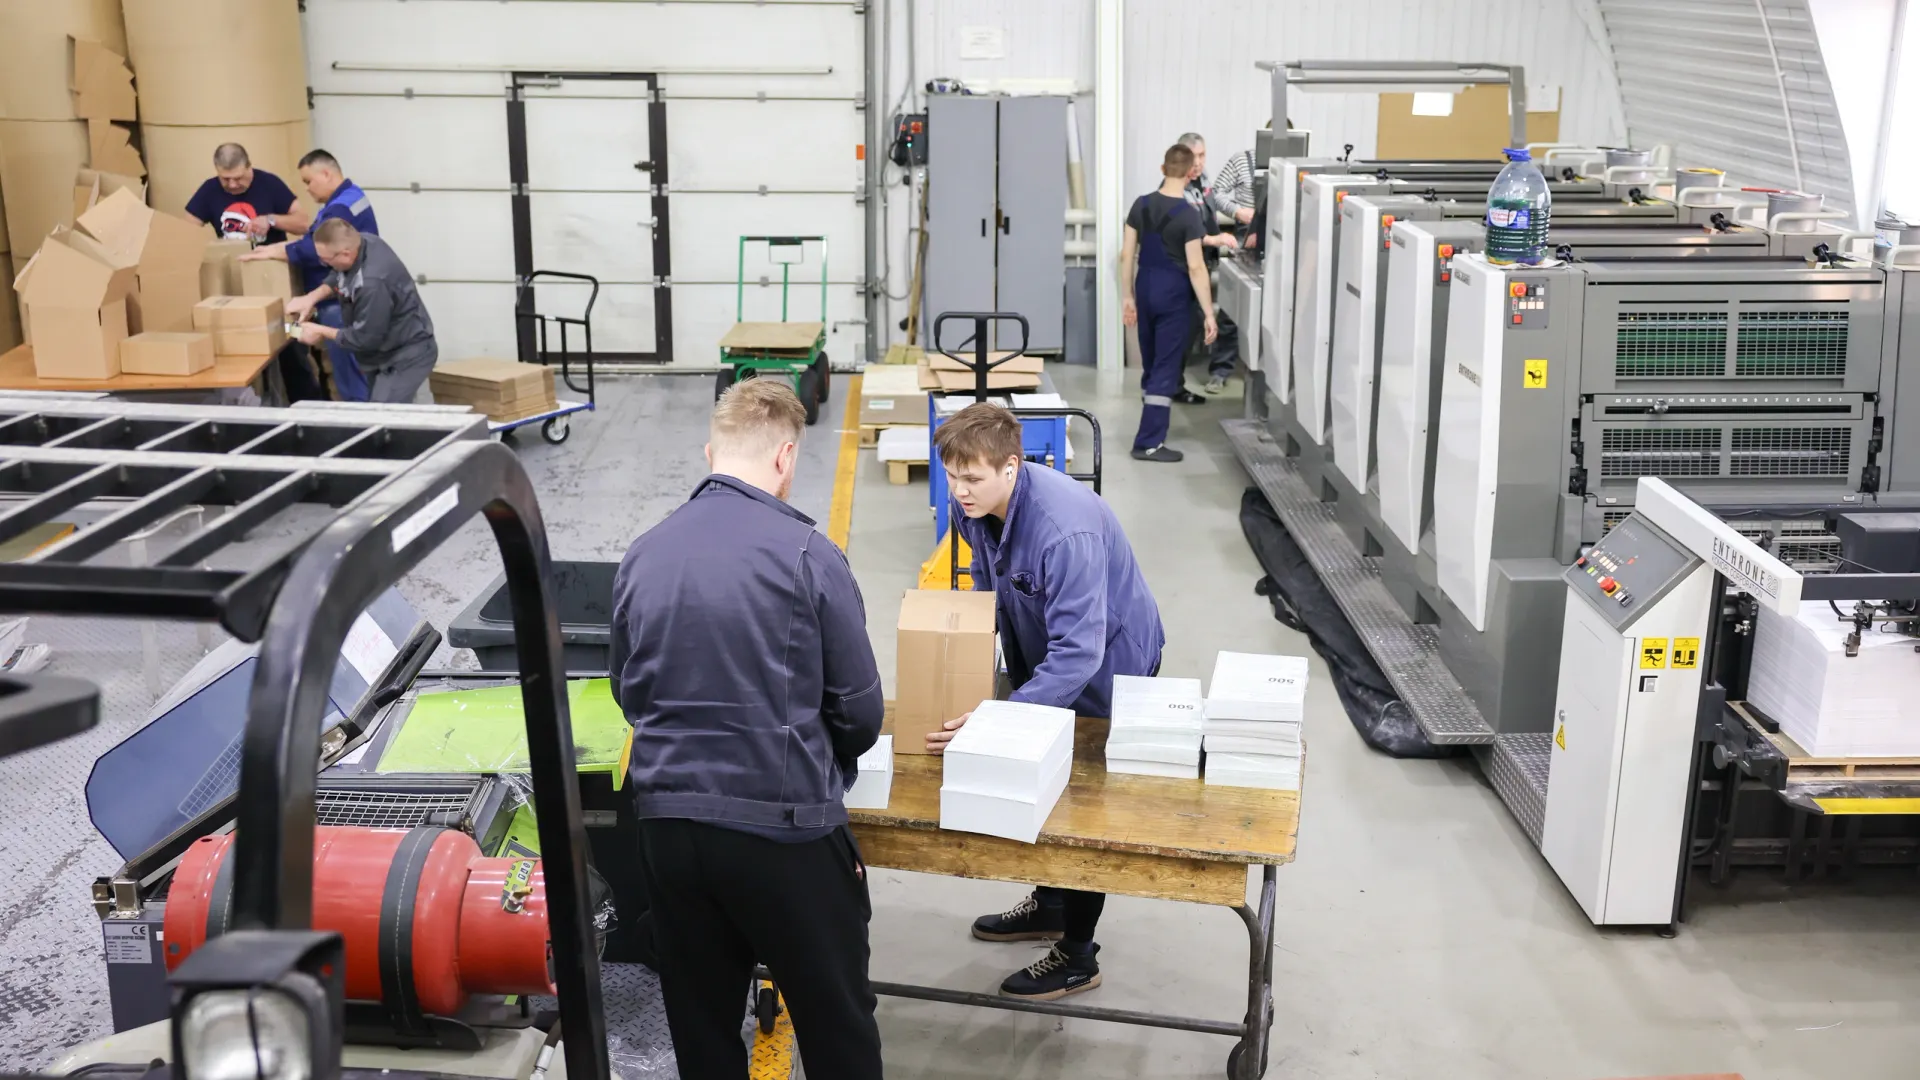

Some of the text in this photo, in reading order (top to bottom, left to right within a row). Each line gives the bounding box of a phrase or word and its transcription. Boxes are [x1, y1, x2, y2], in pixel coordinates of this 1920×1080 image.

[1711, 555, 1763, 599] KOMORI CORPORATION
[1713, 537, 1766, 586] ENTHRONE
